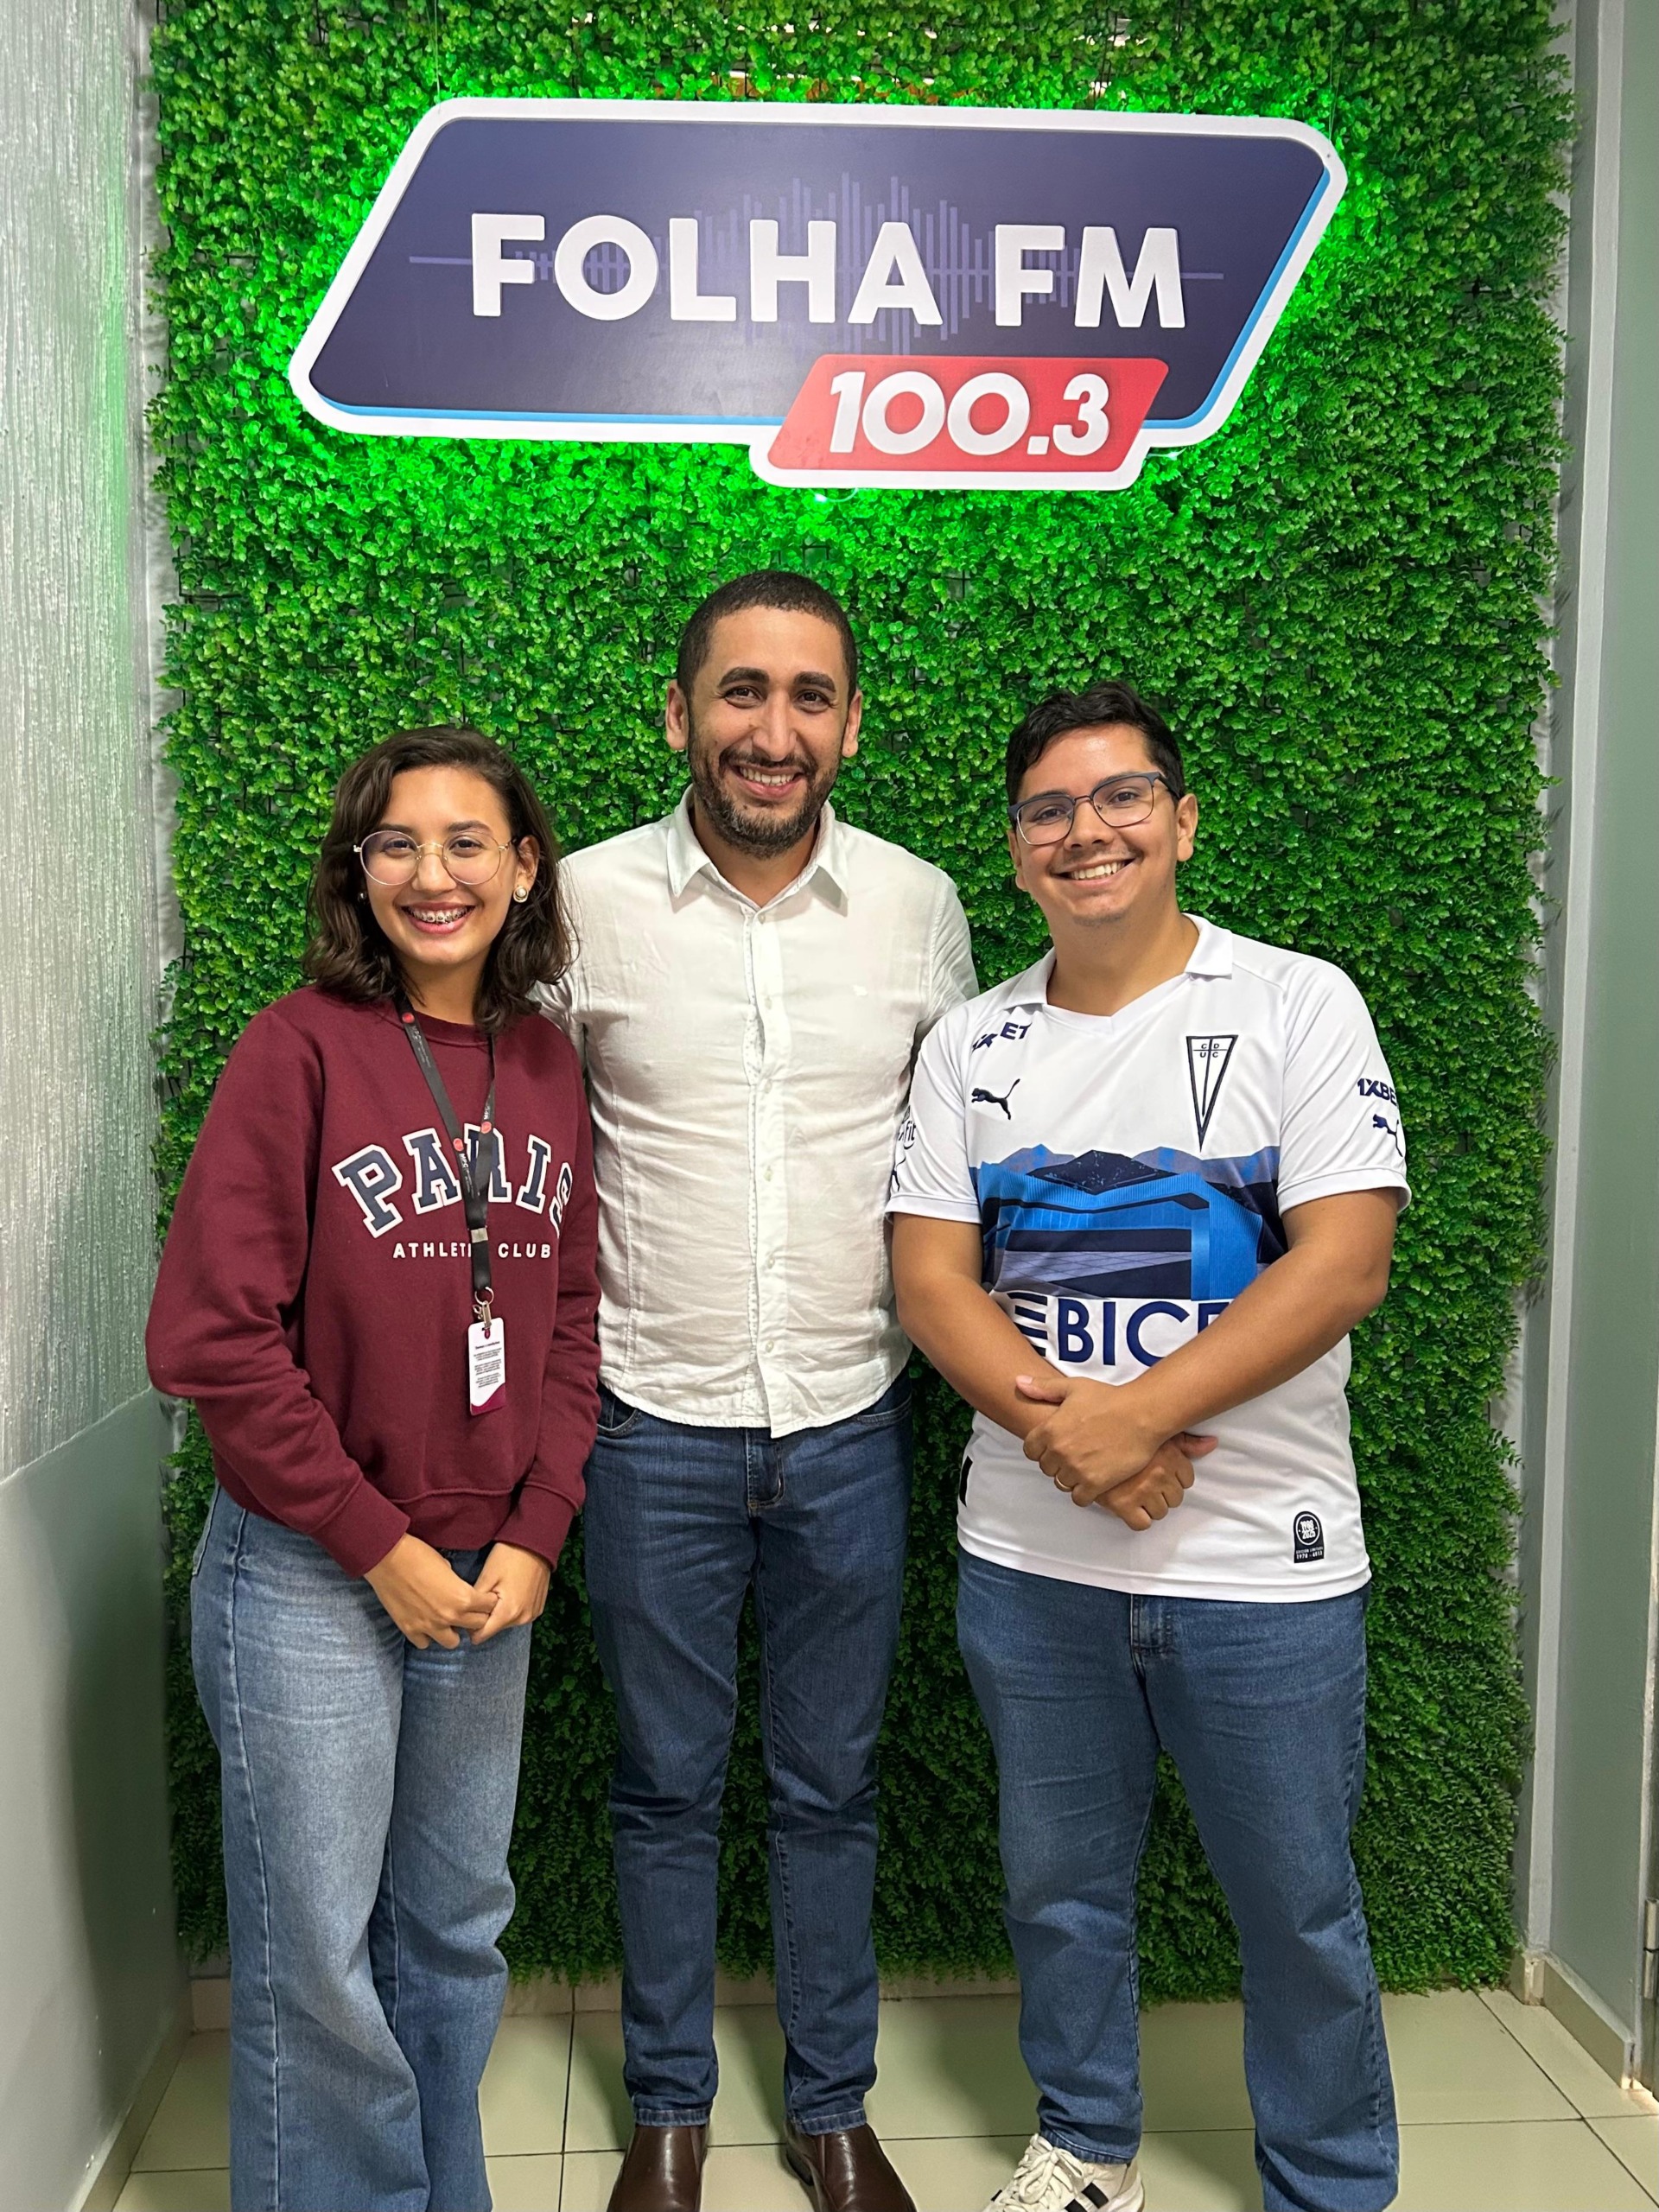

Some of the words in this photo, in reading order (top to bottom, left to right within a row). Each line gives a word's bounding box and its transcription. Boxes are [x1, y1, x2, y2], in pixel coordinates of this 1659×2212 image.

[471, 213, 943, 326] FOLHA
[995, 224, 1186, 329] FM
[827, 372, 1111, 456] 100.3
[1357, 1077, 1398, 1107] 1XBE
[393, 1243, 472, 1259] ATHLETI
[498, 1243, 551, 1259] CLUB
